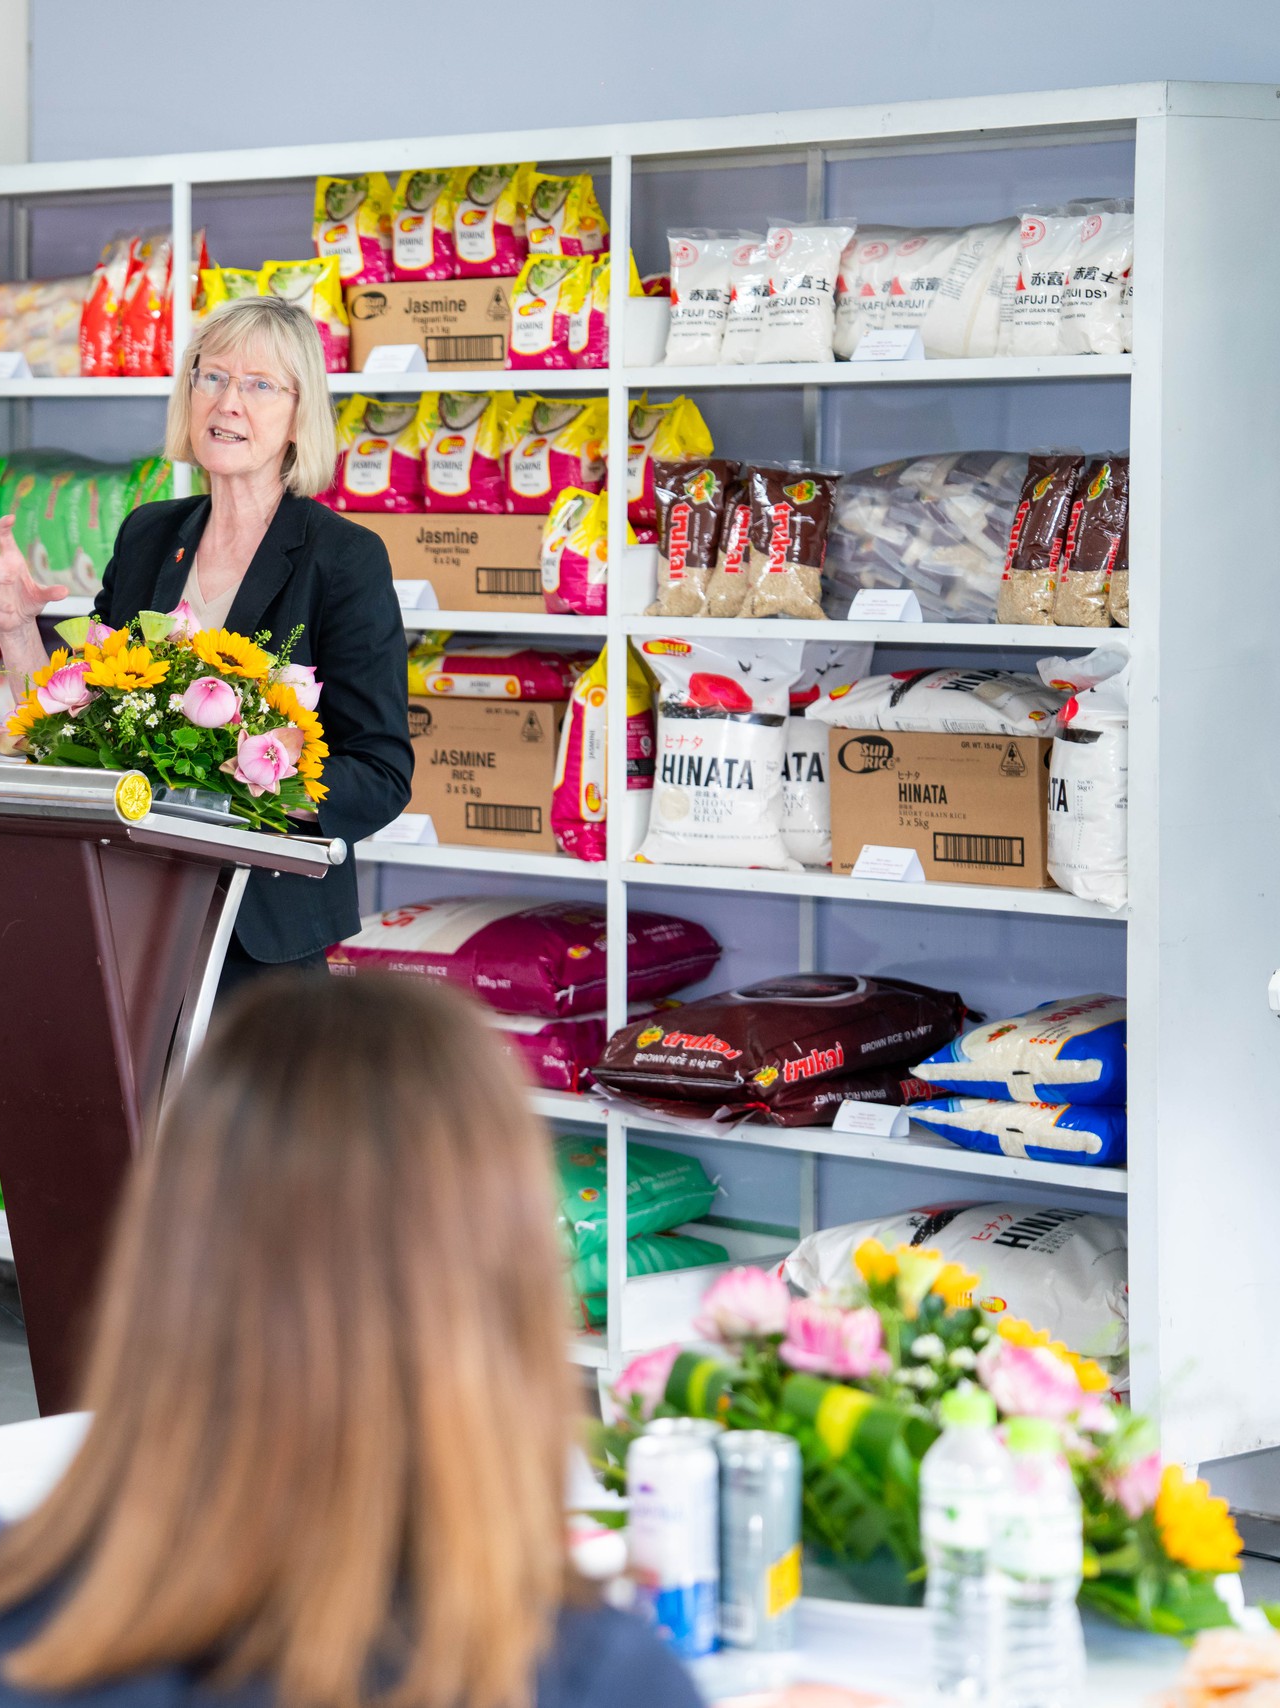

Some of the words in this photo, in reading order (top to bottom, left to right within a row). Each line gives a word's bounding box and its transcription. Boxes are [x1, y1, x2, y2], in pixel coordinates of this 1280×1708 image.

[910, 277, 942, 292] 赤富
[1031, 271, 1064, 286] 赤富
[800, 295, 821, 306] DS1
[1085, 289, 1108, 299] DS1
[404, 296, 467, 314] Jasmine
[1058, 497, 1070, 530] Natural
[1066, 468, 1077, 496] Brown
[417, 526, 479, 545] Jasmine
[669, 501, 694, 580] trukai
[769, 501, 794, 574] trukai
[665, 734, 703, 750] ヒナタ
[431, 749, 497, 768] JASMINE
[452, 770, 475, 781] RICE
[662, 753, 754, 790] HINATA
[781, 752, 826, 783] ATA
[898, 770, 920, 780] ヒナタ
[446, 783, 451, 794] 3
[454, 786, 459, 794] x
[462, 784, 468, 795] 5
[471, 785, 482, 798] kg
[898, 782, 948, 804] HINATA
[899, 817, 904, 826] 3
[914, 818, 929, 829] 5kg
[329, 964, 357, 978] NGOLD
[388, 963, 425, 975] JASMINE
[426, 965, 448, 977] RICE
[498, 979, 512, 989] NET
[662, 1030, 743, 1061] trukai
[861, 1037, 887, 1053] BROWN
[634, 1053, 666, 1065] BROWN
[707, 1060, 723, 1069] NET
[783, 1041, 845, 1083] trukai
[844, 1090, 860, 1100] RICE
[860, 1088, 887, 1099] BROWN
[971, 1213, 1013, 1242] ヒナタ
